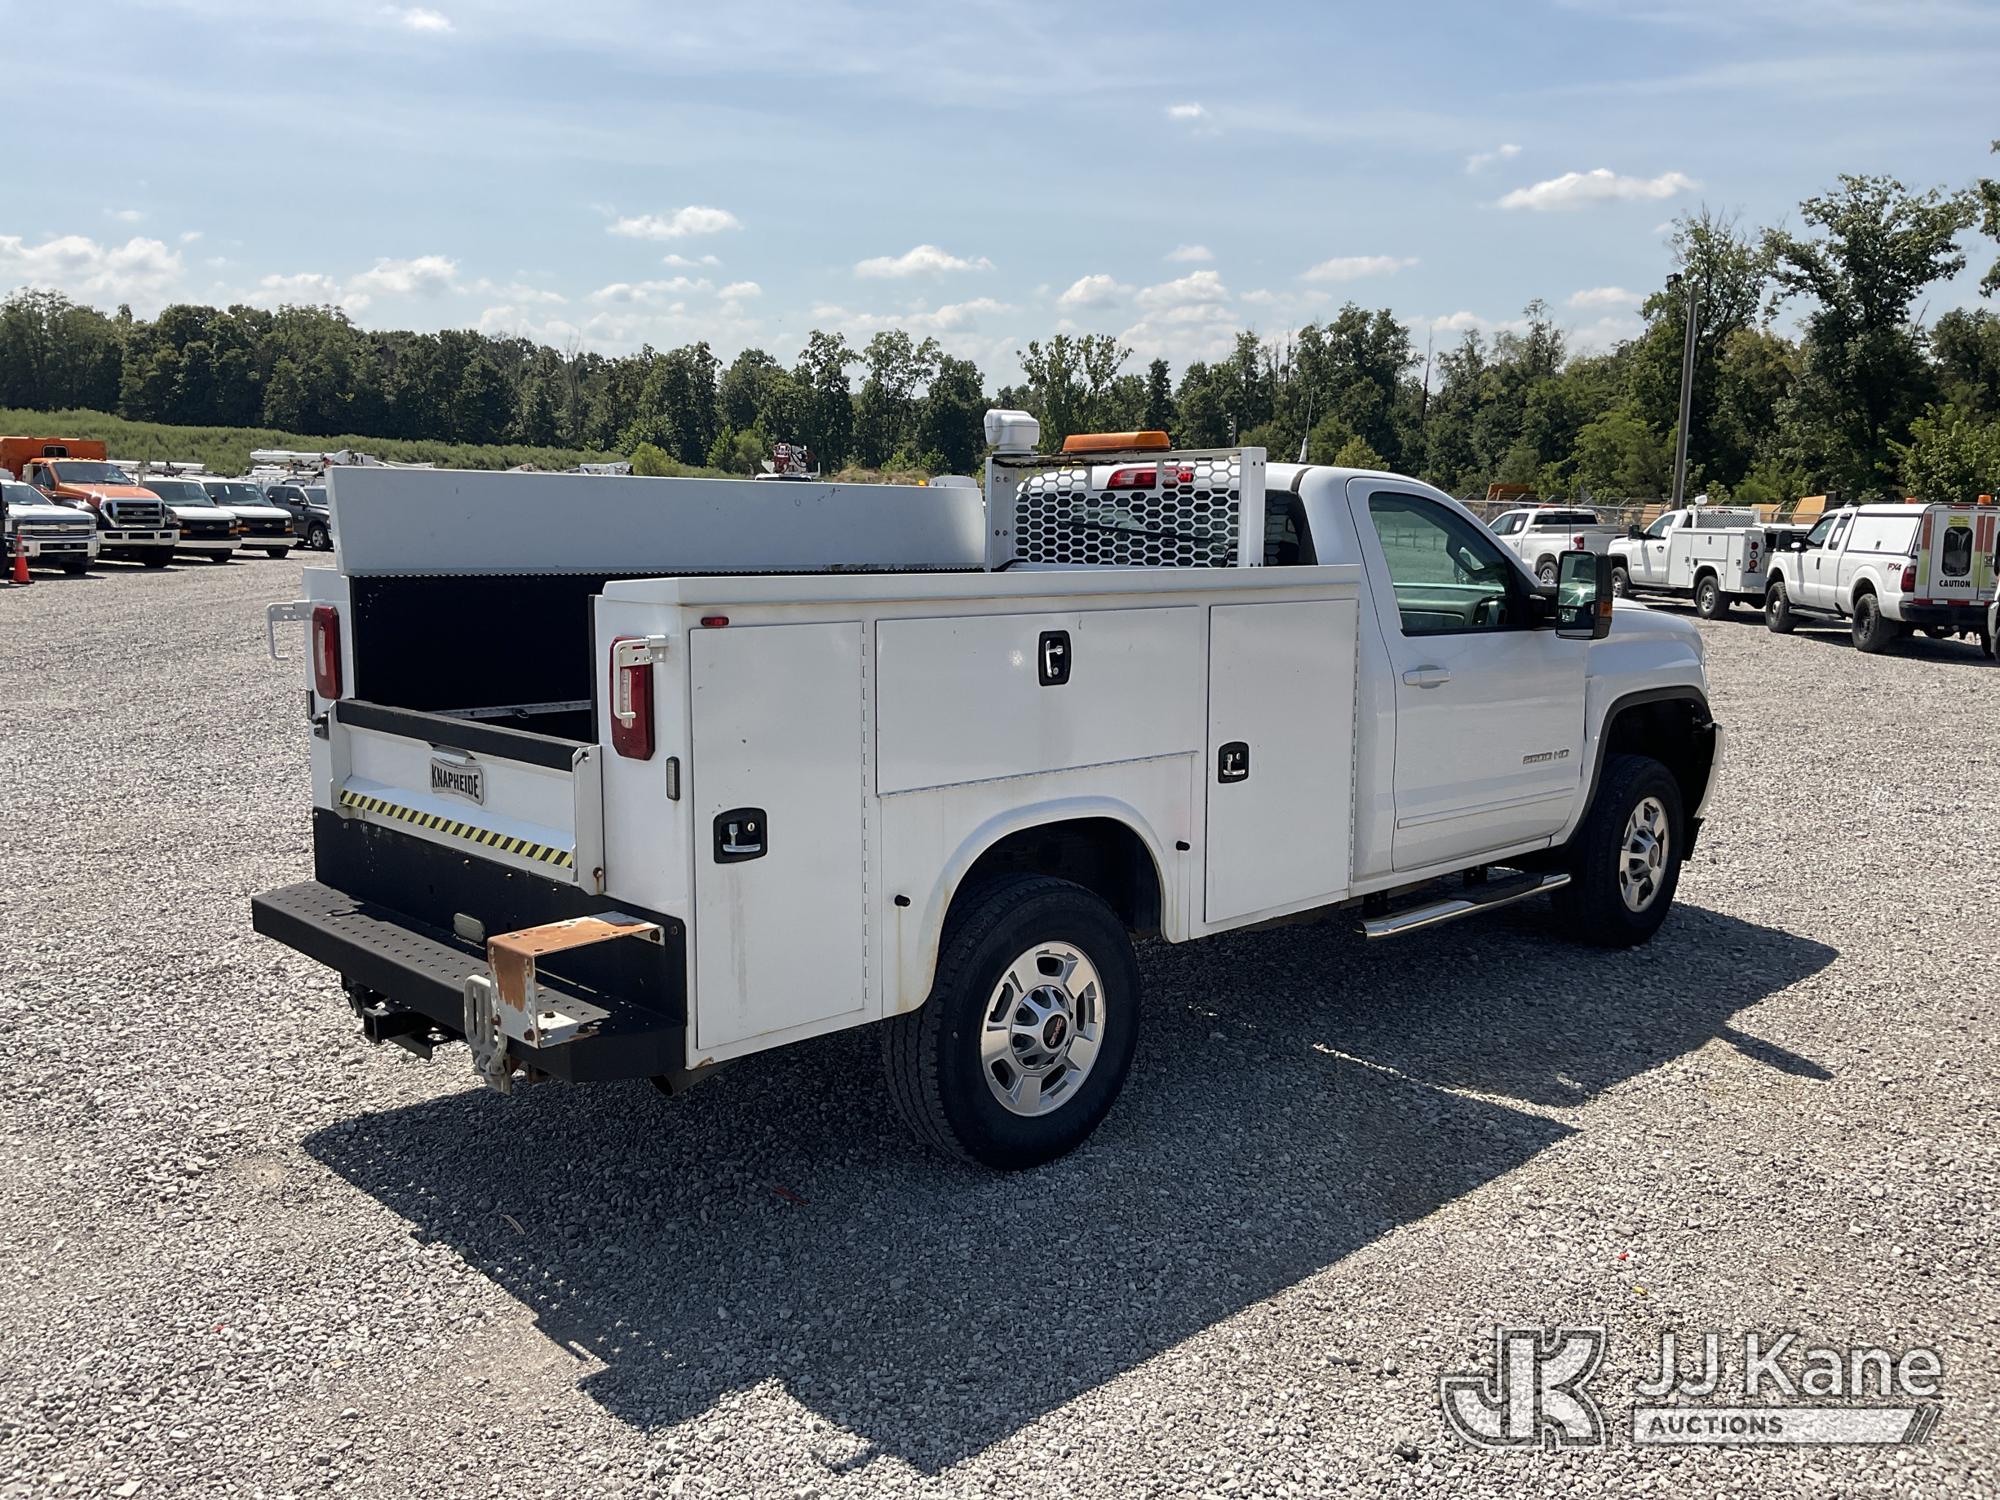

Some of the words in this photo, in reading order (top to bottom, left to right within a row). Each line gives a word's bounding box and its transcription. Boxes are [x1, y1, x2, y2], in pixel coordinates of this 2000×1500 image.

[1887, 562, 1902, 571] FX4
[1939, 580, 1971, 588] CAUTION
[431, 763, 480, 800] KNAPHEIDE
